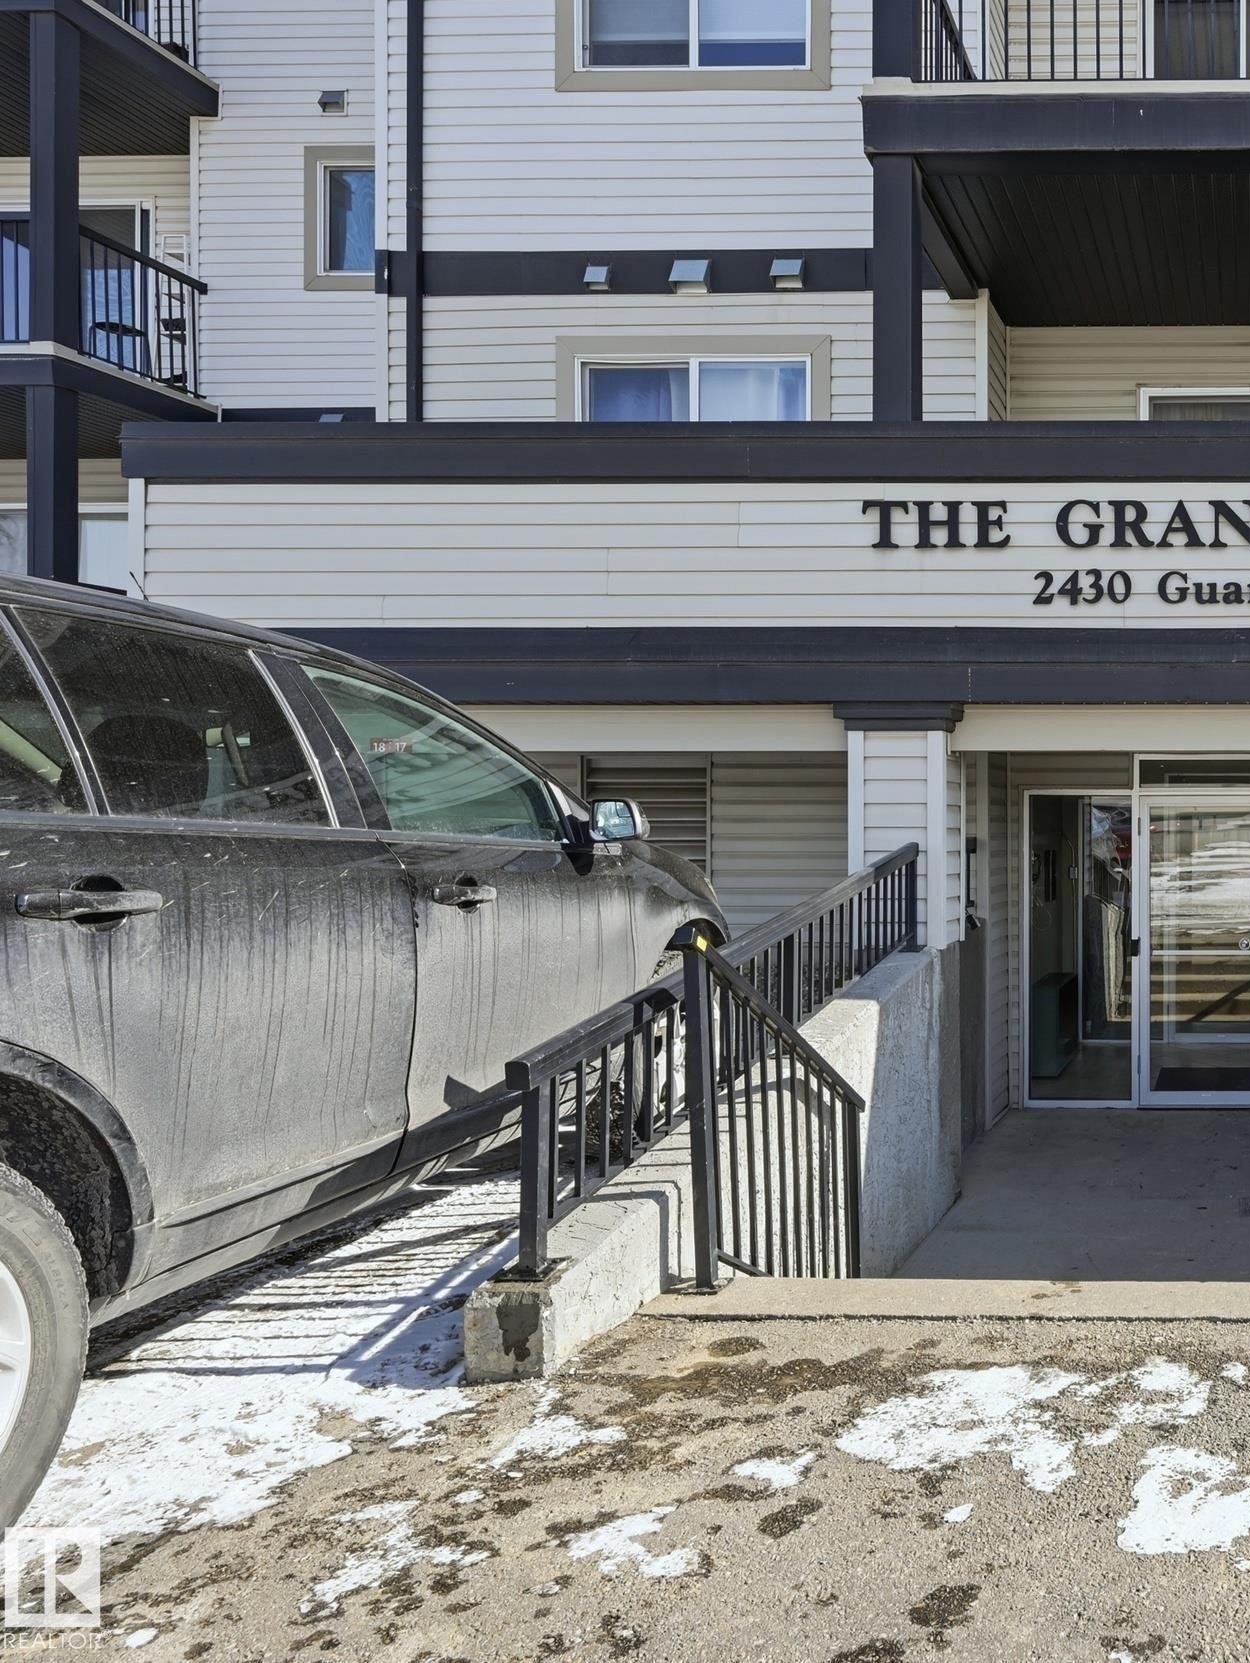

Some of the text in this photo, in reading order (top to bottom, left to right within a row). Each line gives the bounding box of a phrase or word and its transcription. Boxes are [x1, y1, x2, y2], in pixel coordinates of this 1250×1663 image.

[862, 499, 1011, 549] THE
[1033, 569, 1132, 606] 2430
[372, 742, 407, 752] 18 17
